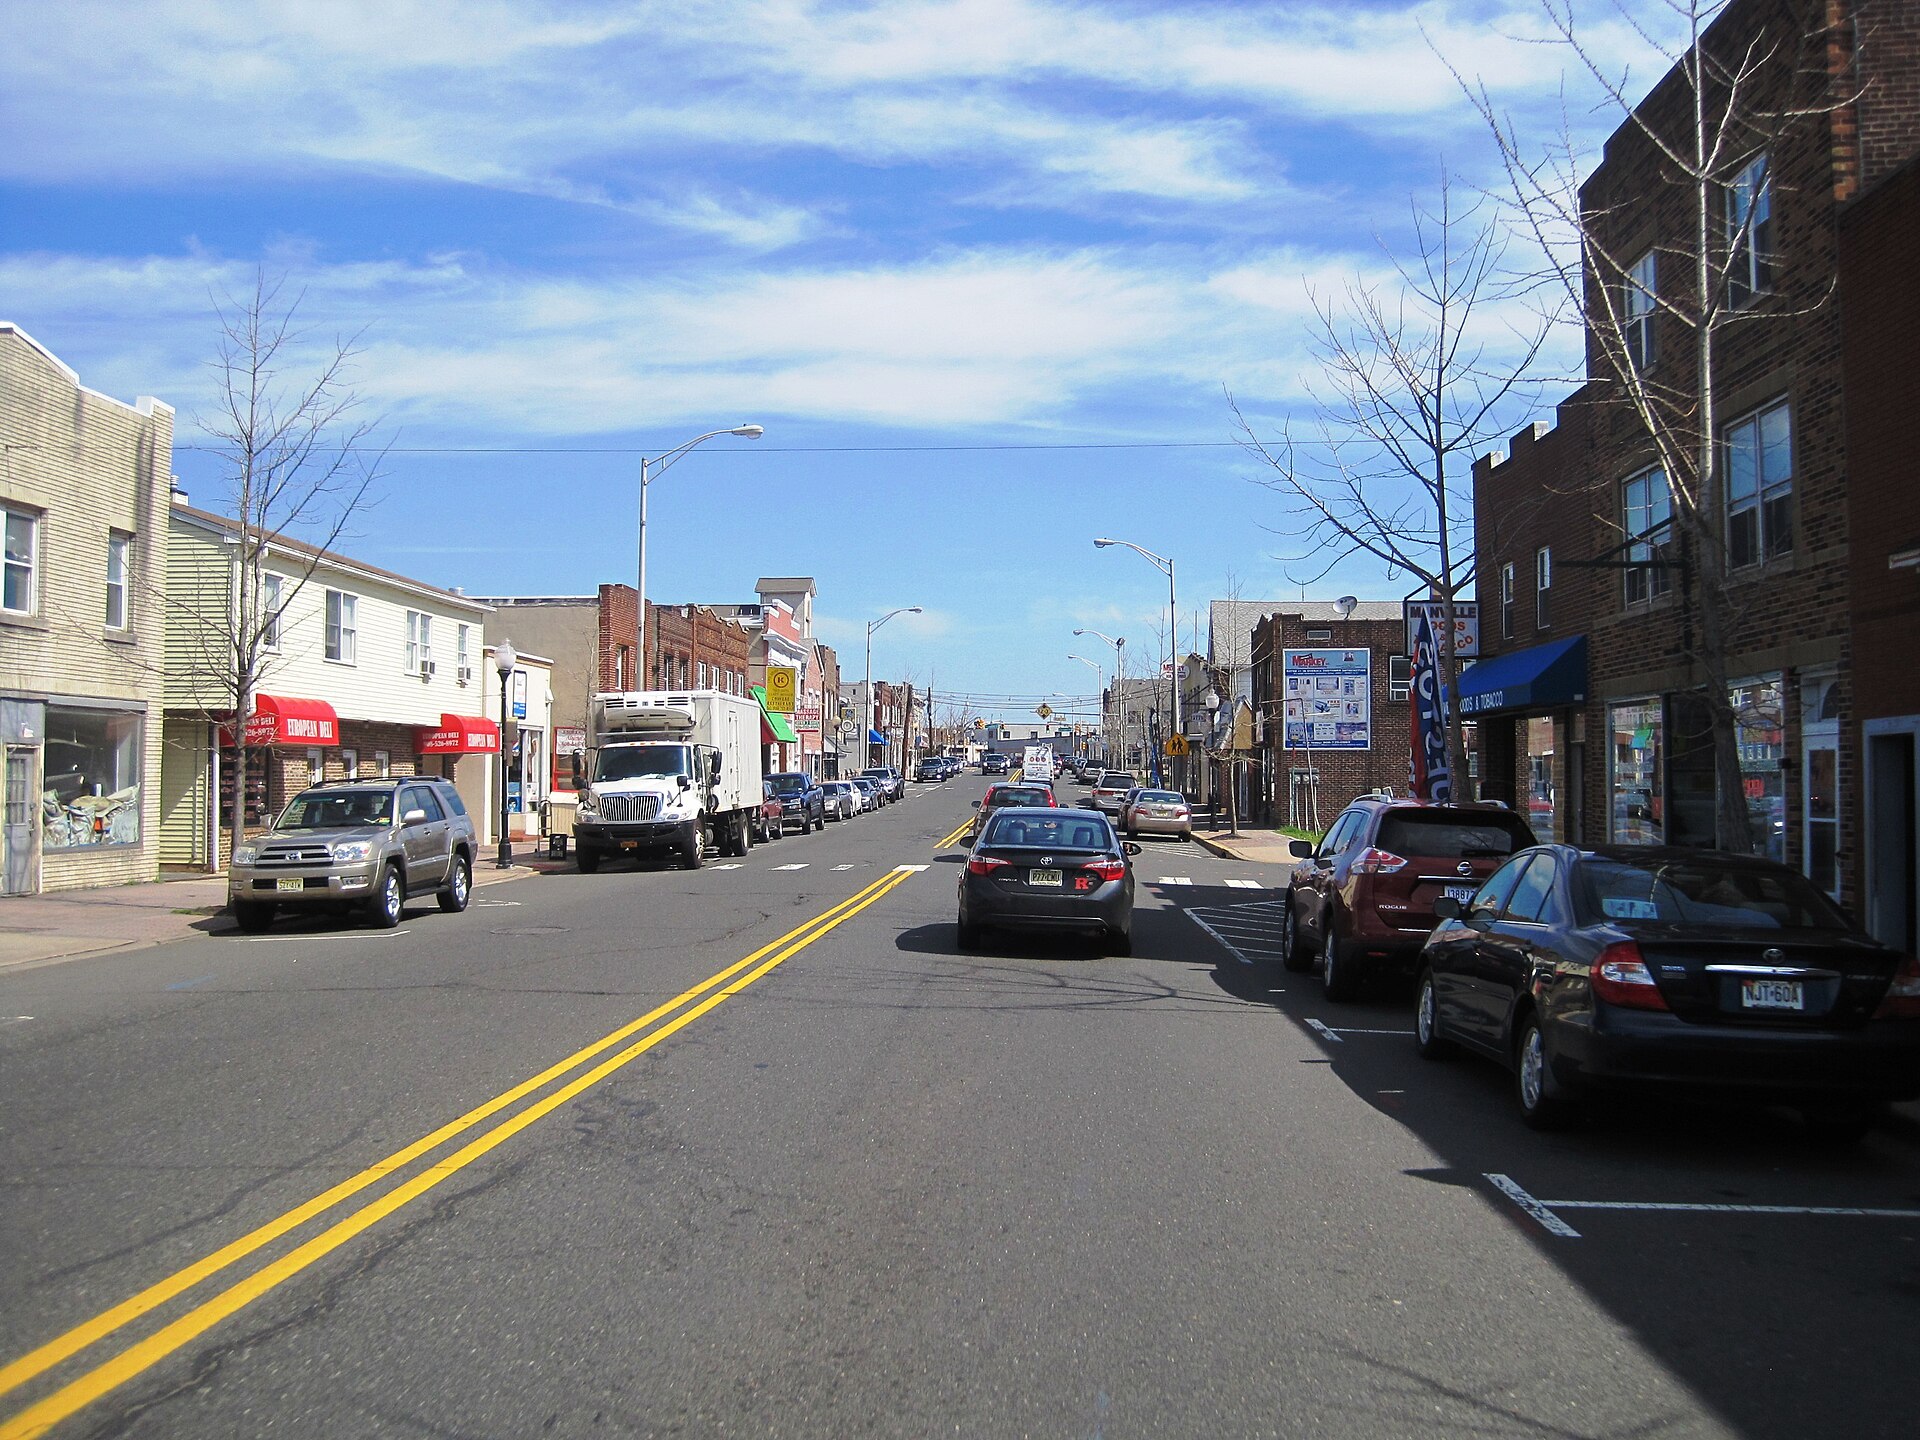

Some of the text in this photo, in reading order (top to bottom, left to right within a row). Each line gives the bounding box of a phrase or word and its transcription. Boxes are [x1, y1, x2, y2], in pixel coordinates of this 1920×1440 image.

[1480, 691, 1503, 709] TOBACCO
[287, 719, 333, 738] EUROPEAN DELI
[1075, 877, 1089, 890] R
